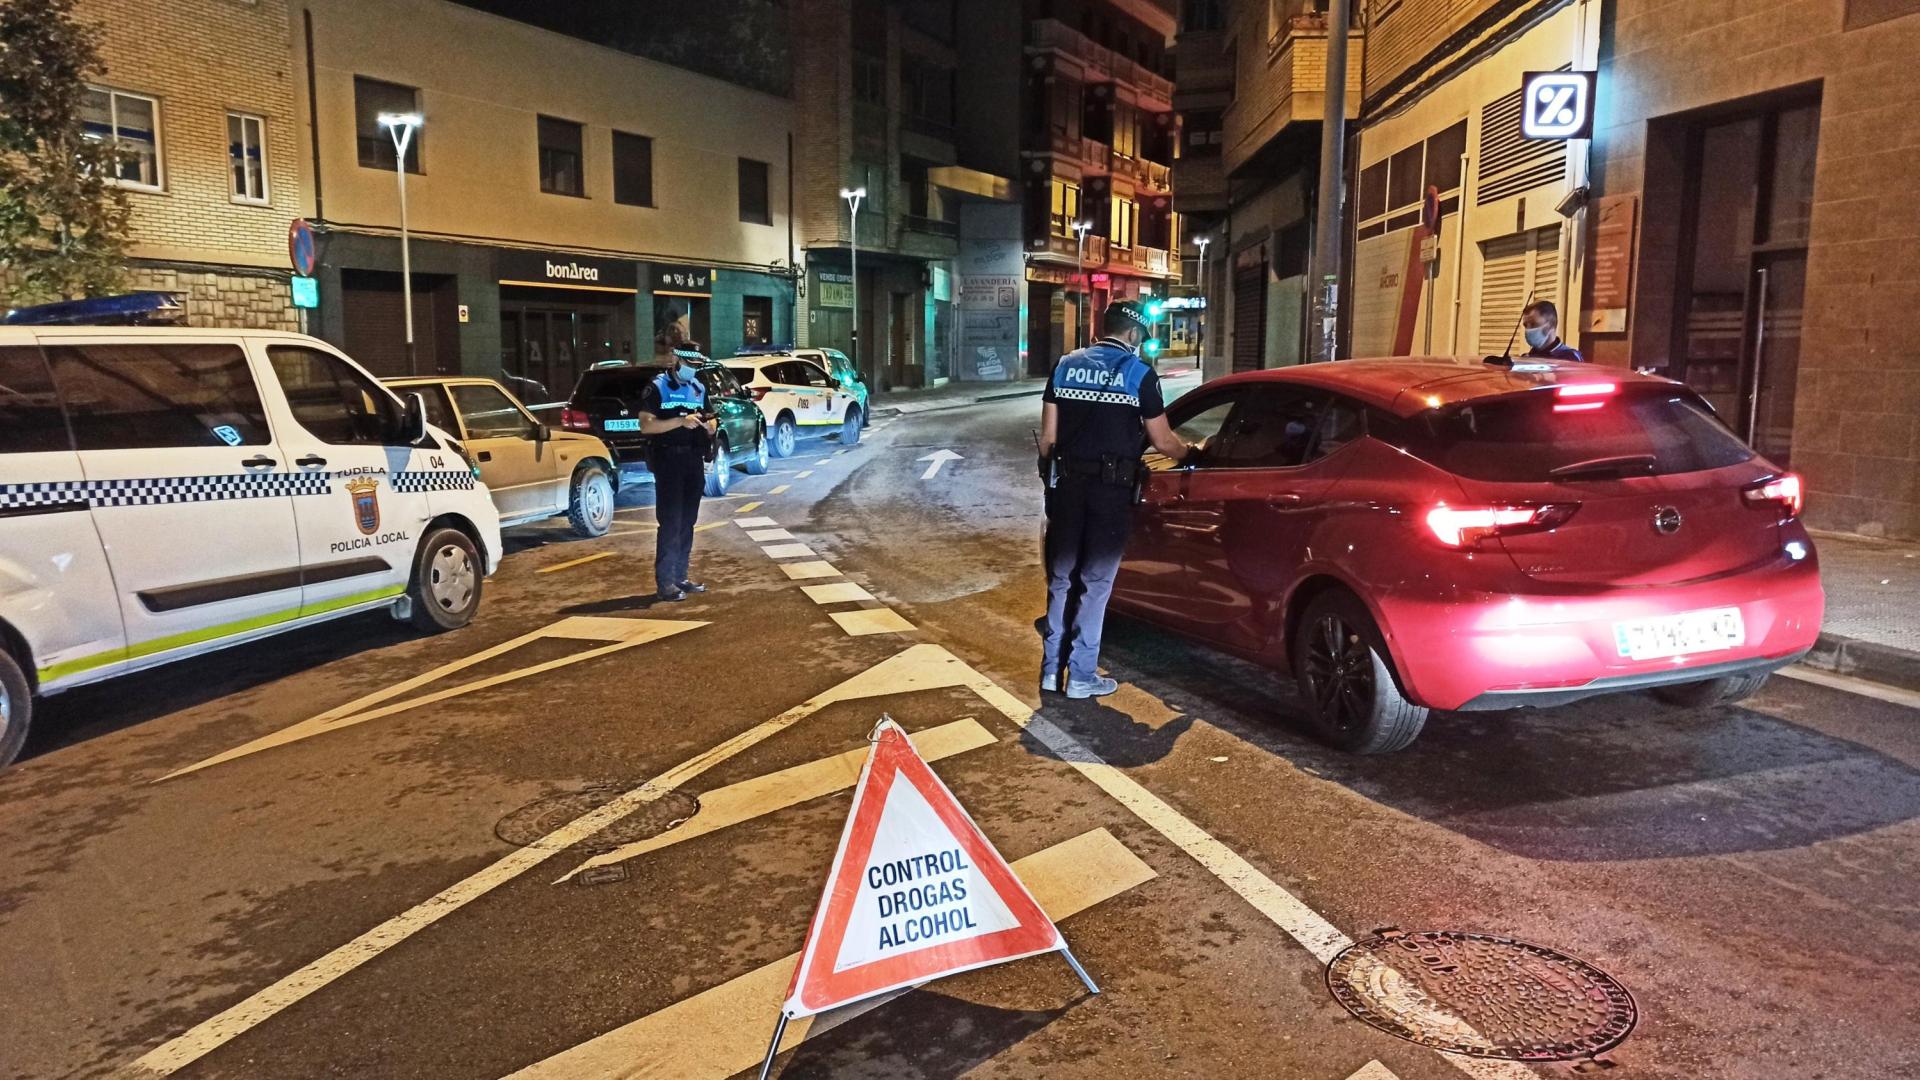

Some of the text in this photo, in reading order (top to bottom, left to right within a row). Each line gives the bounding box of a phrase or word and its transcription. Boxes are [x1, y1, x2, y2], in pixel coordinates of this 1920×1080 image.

[546, 260, 598, 281] bonArea
[836, 275, 853, 283] EDIFIC
[335, 466, 386, 478] TUDELA
[430, 456, 444, 468] 04
[331, 531, 409, 553] POLICIA LOCAL
[868, 849, 968, 889] CONTROL
[878, 878, 967, 918] DROGAS
[879, 907, 976, 950] ALCOHOL
